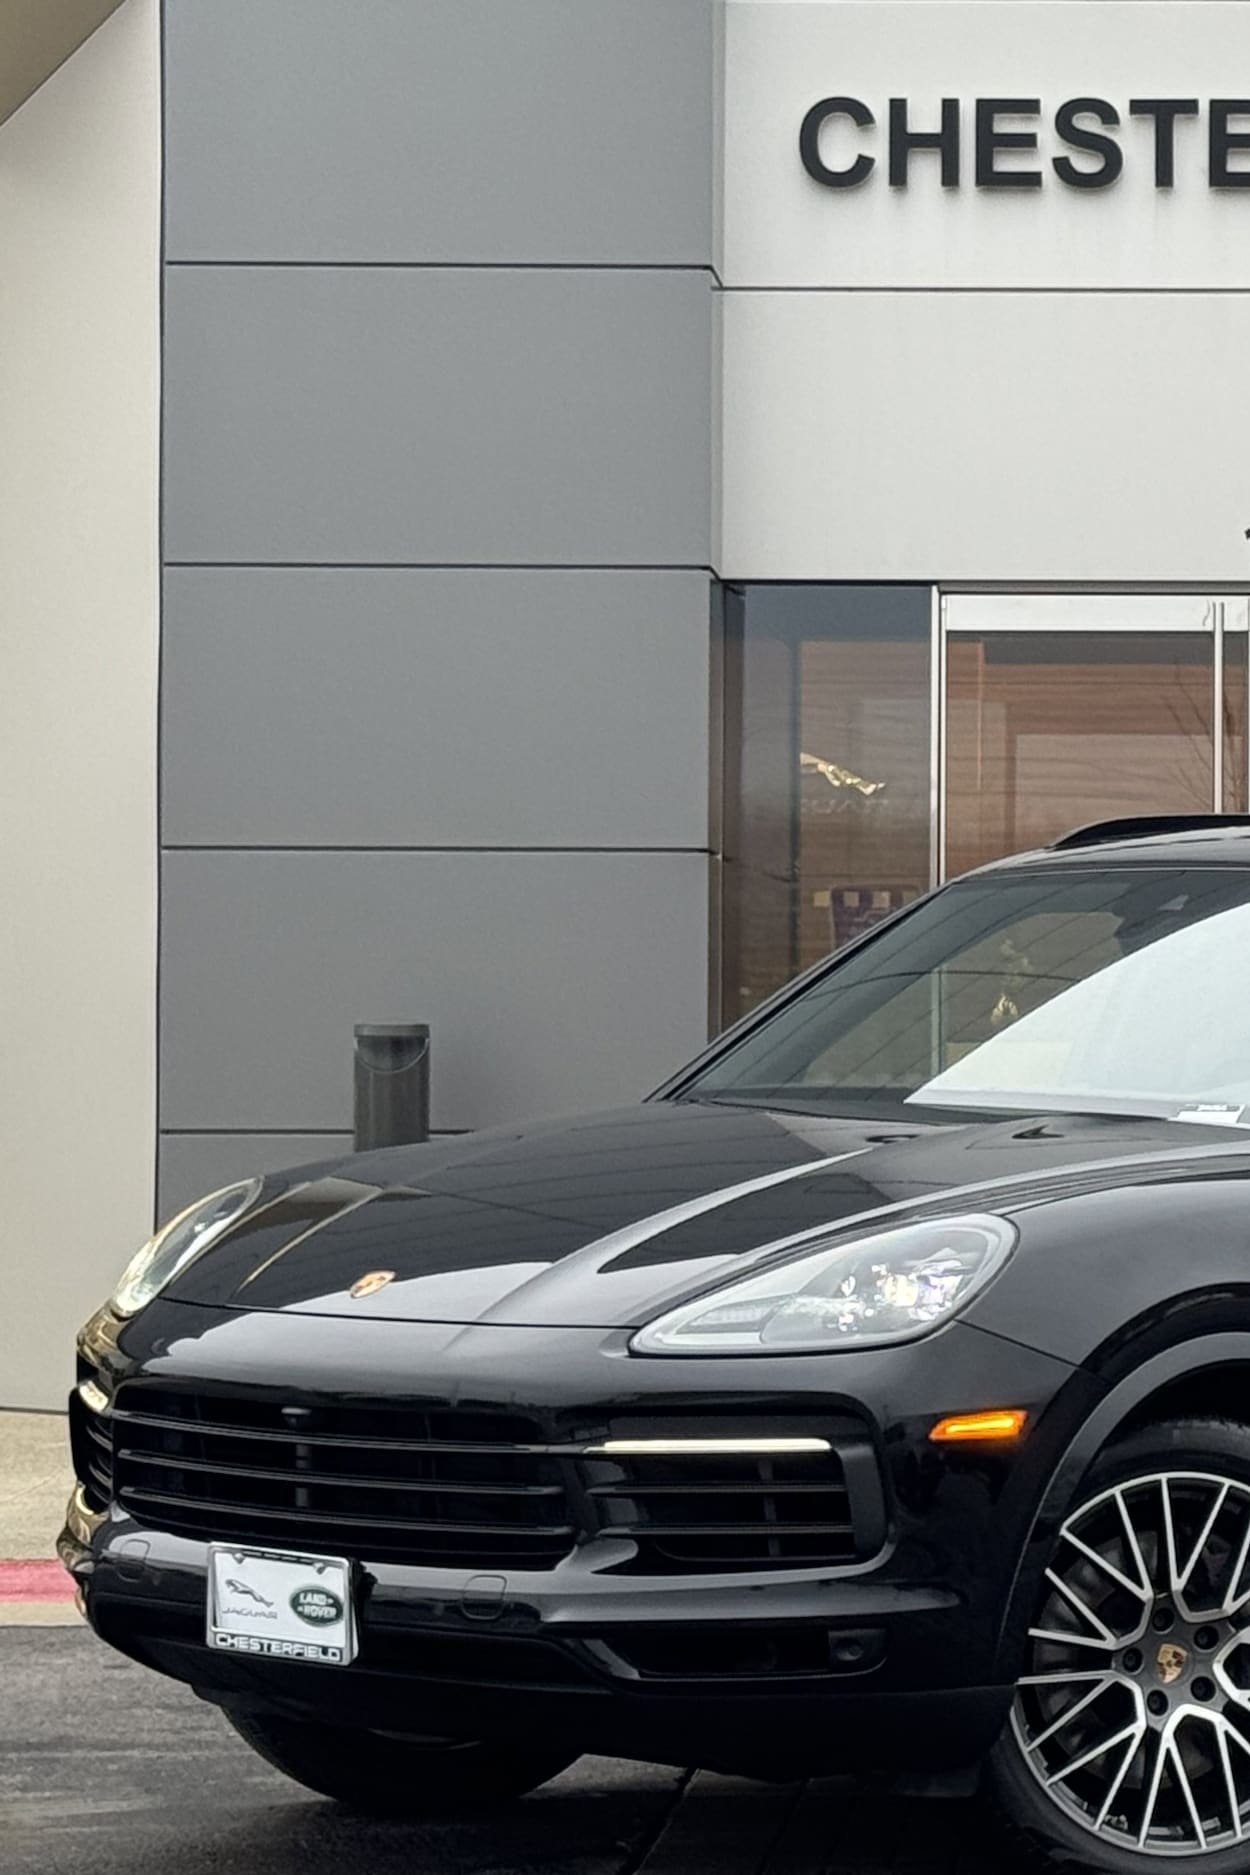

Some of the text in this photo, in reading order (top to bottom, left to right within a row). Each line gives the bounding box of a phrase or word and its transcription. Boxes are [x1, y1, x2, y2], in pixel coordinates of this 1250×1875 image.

[299, 1592, 328, 1606] LAND
[222, 1607, 278, 1620] JAGUAR
[303, 1605, 337, 1619] ROVER
[215, 1633, 341, 1662] CHESTERFIELD
